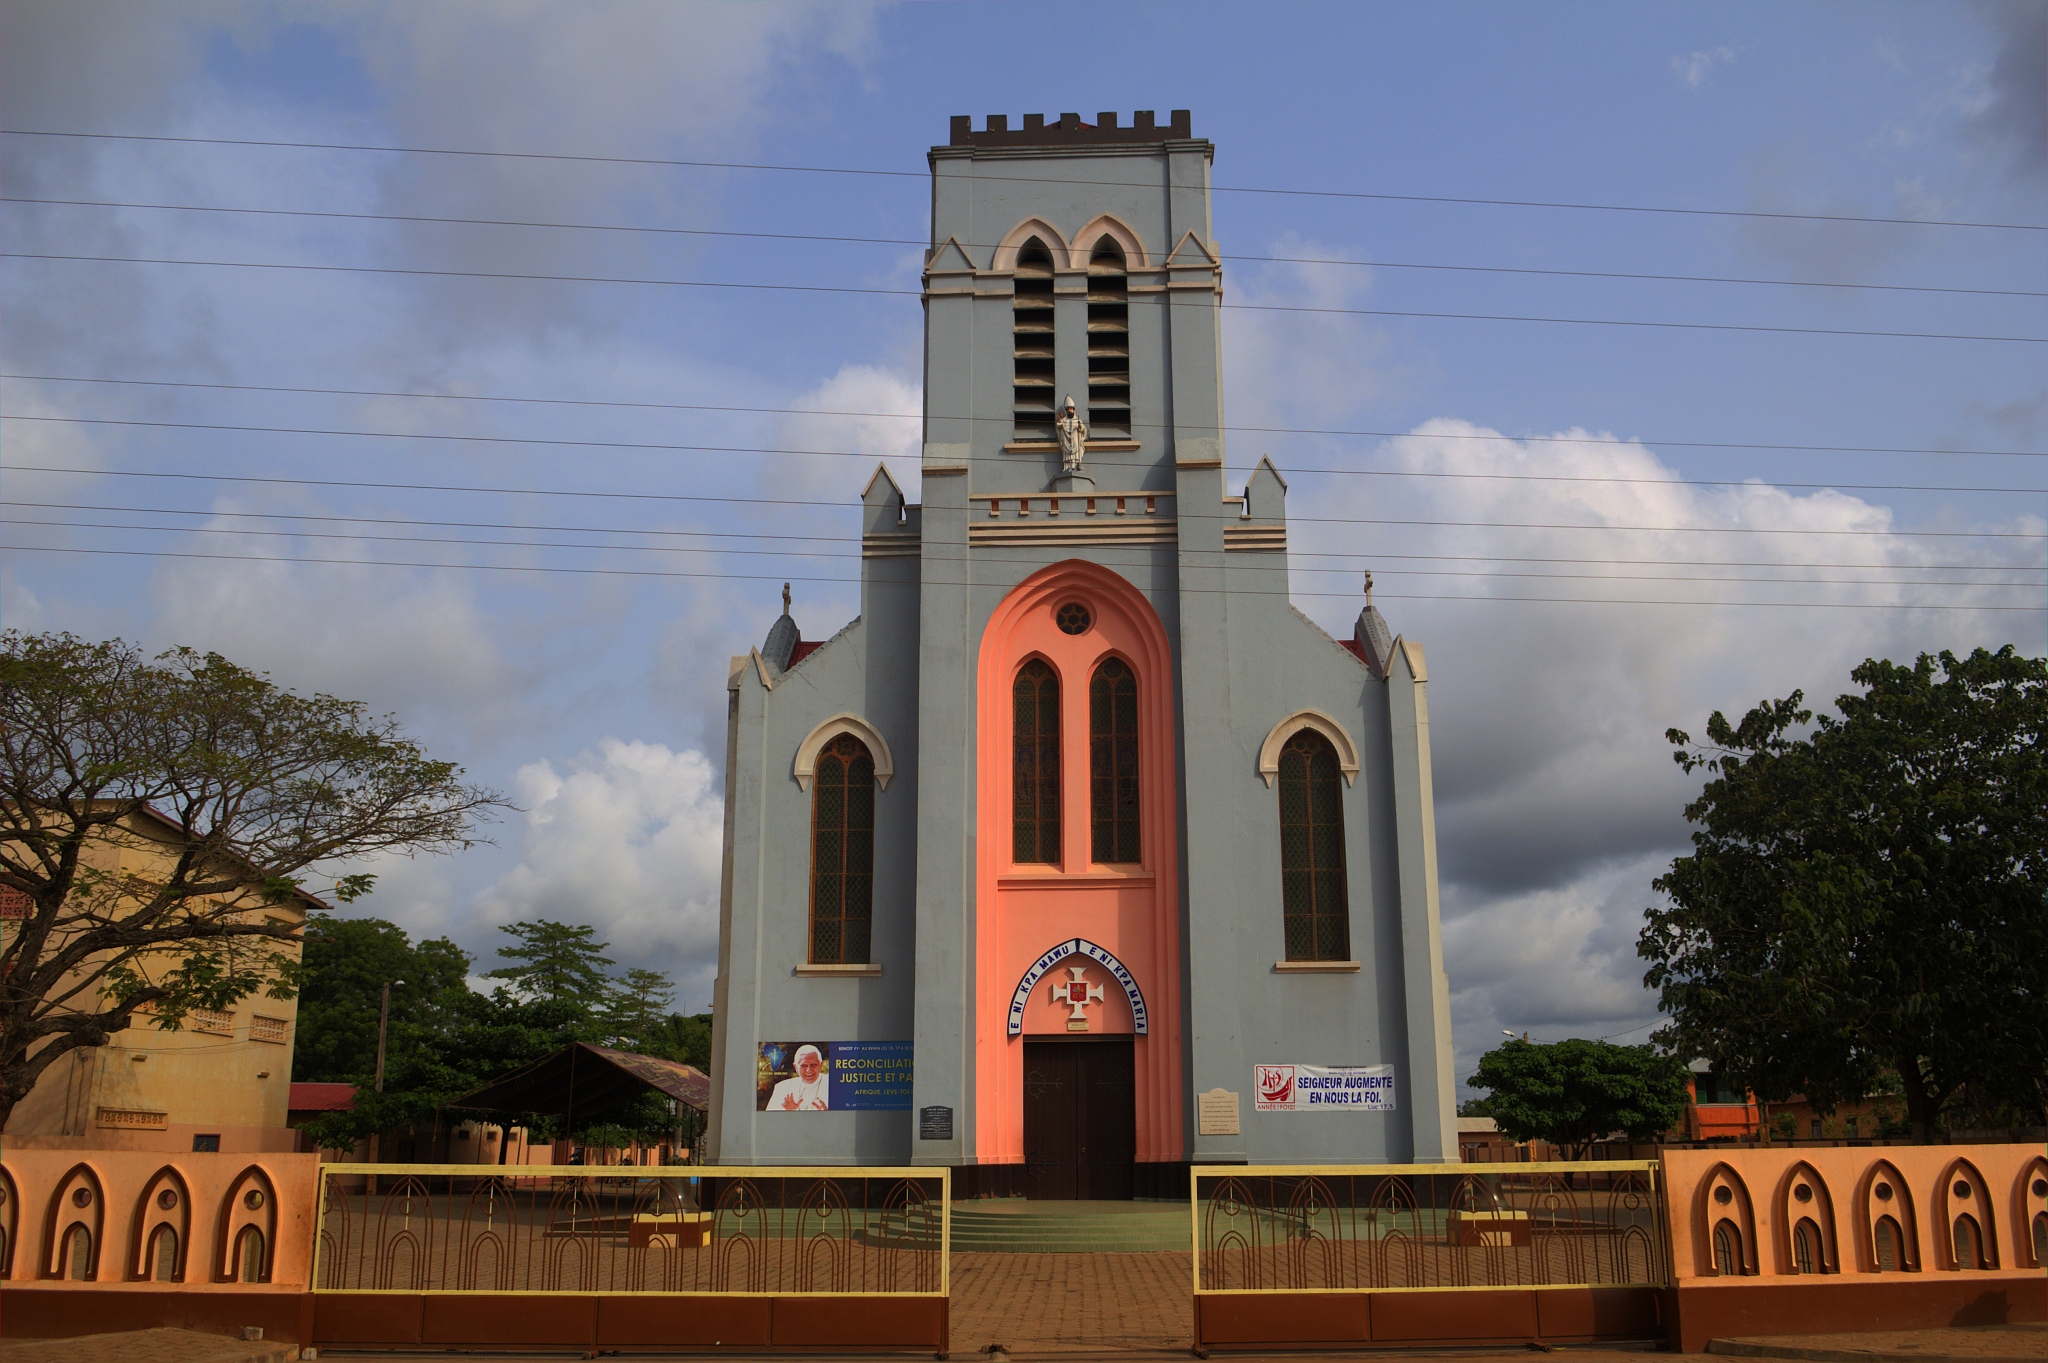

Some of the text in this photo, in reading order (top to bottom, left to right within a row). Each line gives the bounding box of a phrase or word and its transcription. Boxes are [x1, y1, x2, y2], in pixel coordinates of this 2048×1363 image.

[1013, 1000, 1024, 1014] NI
[1020, 971, 1038, 994] KPA
[1038, 945, 1070, 970] MAWU
[1088, 946, 1146, 1030] E NI KPA MARIA
[835, 1059, 914, 1069] RECONCILIATI
[839, 1073, 882, 1083] JUSTICE
[885, 1073, 896, 1083] ET
[1297, 1076, 1393, 1089] SEIGNEUR AUGMENTE
[1309, 1091, 1382, 1103] EN NOUS LA FOI.
